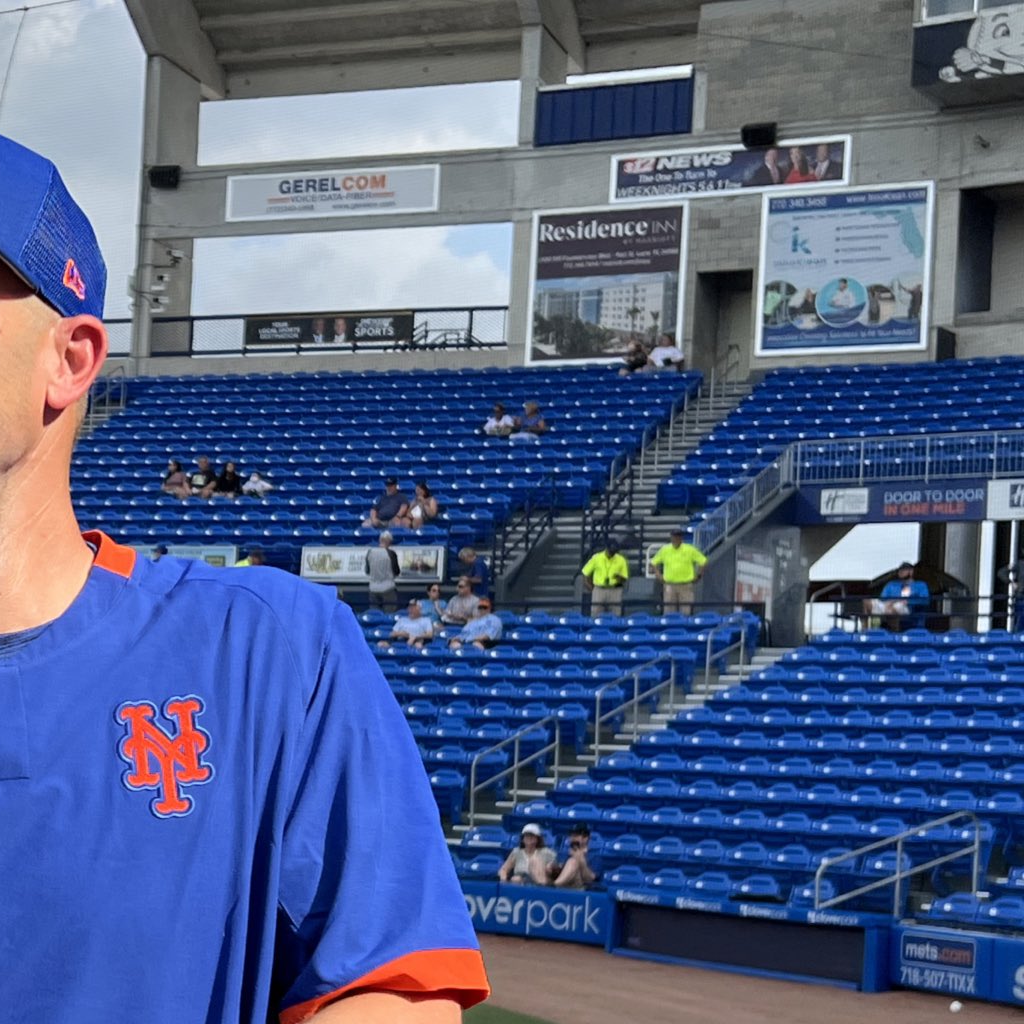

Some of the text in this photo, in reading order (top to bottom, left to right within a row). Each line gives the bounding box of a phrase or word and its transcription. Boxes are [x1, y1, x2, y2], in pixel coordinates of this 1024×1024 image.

[656, 151, 732, 170] NEWS
[278, 174, 387, 195] GERELCOM
[617, 183, 696, 198] WEEKNIGHTS
[539, 219, 678, 243] Residence INN
[354, 326, 395, 337] SPORTS
[884, 488, 984, 504] DOOR TO DOOR
[884, 502, 966, 516] IN ONE MILE
[116, 697, 214, 818] NY
[905, 942, 972, 966] mets.com
